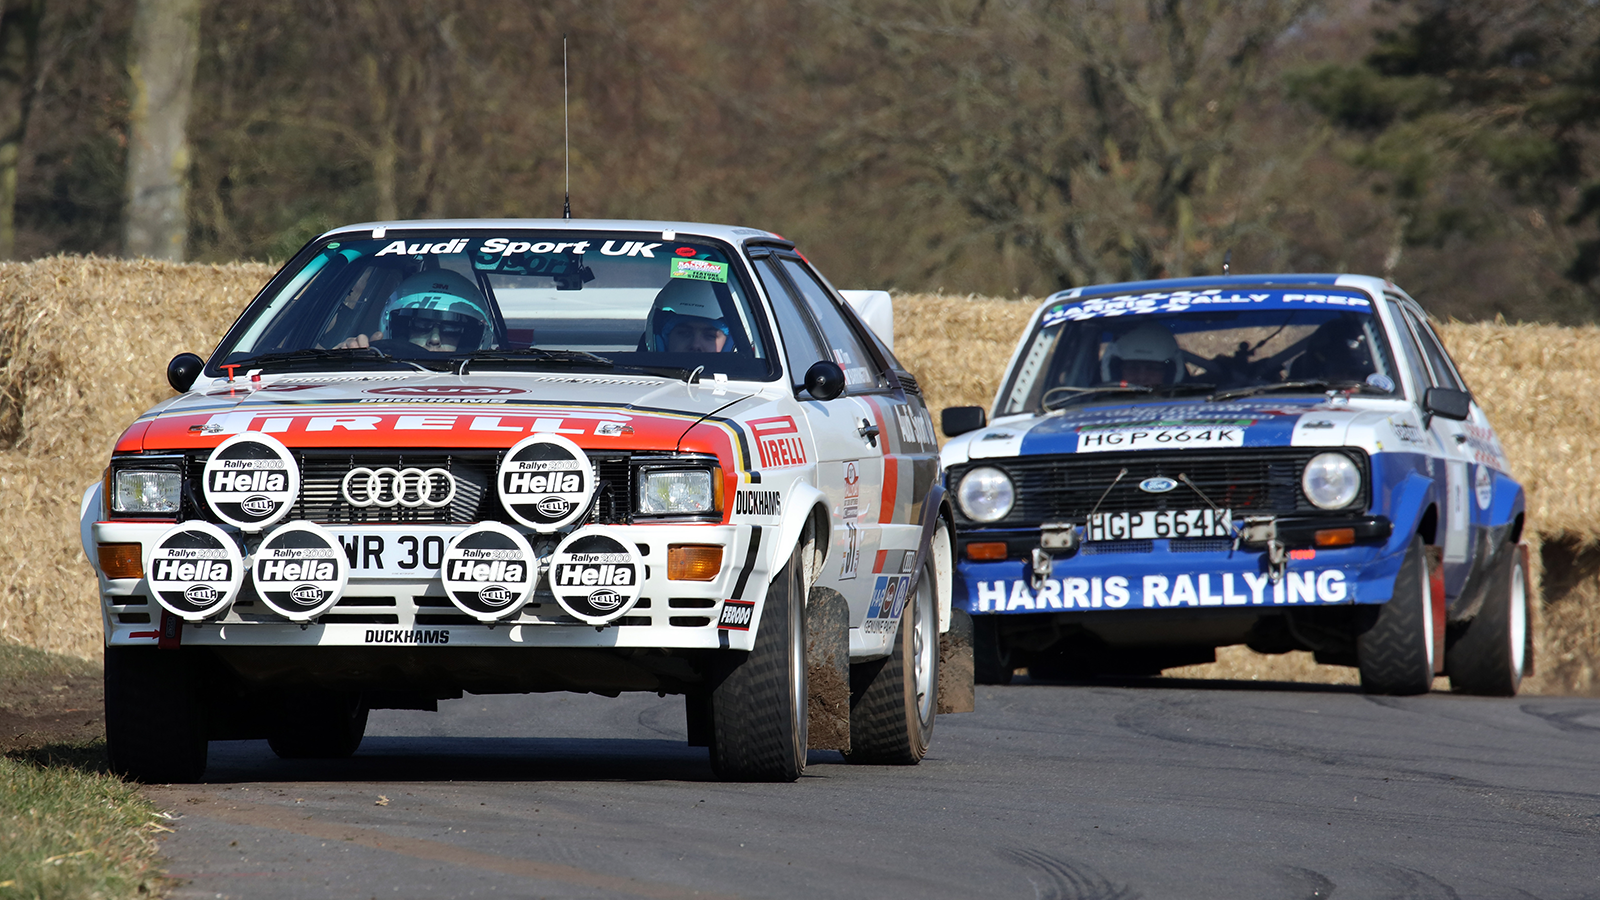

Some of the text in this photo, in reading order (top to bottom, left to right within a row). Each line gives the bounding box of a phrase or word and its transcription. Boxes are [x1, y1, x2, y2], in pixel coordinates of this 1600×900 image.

[375, 238, 662, 258] Audi Sport UK
[1168, 294, 1270, 305] RALLY
[1283, 294, 1370, 306] PREP
[200, 410, 632, 437] PIRELLI
[745, 415, 807, 468] PIRELLI
[1084, 431, 1147, 446] HGP
[1155, 430, 1234, 443] 664K
[224, 460, 284, 469] Rallye 2000
[519, 461, 579, 470] Rallye 2000
[213, 471, 285, 492] Hella
[508, 473, 580, 493] Hella
[243, 500, 274, 511] HELLA
[538, 502, 570, 512] HELLA
[736, 490, 781, 516] DUCKHAMS
[1089, 508, 1232, 539] HGP 664K
[168, 549, 228, 558] Rallye 2000
[273, 549, 334, 558] Rallye 2000
[397, 535, 456, 569] 30
[462, 550, 523, 559] Rallye 2000
[571, 553, 631, 563] Rallye 2000
[156, 560, 229, 581] Hella
[261, 560, 333, 581] Hella
[451, 561, 524, 582] Hella
[559, 565, 631, 586] Hella
[186, 589, 217, 600] HELLA
[292, 589, 324, 600] HELLA
[481, 590, 512, 600] HELLA
[590, 594, 621, 604] HELLA
[977, 570, 1347, 612] HARRIS RALLYING
[721, 608, 750, 624] FERODO
[365, 630, 449, 643] DUCKHAMS
